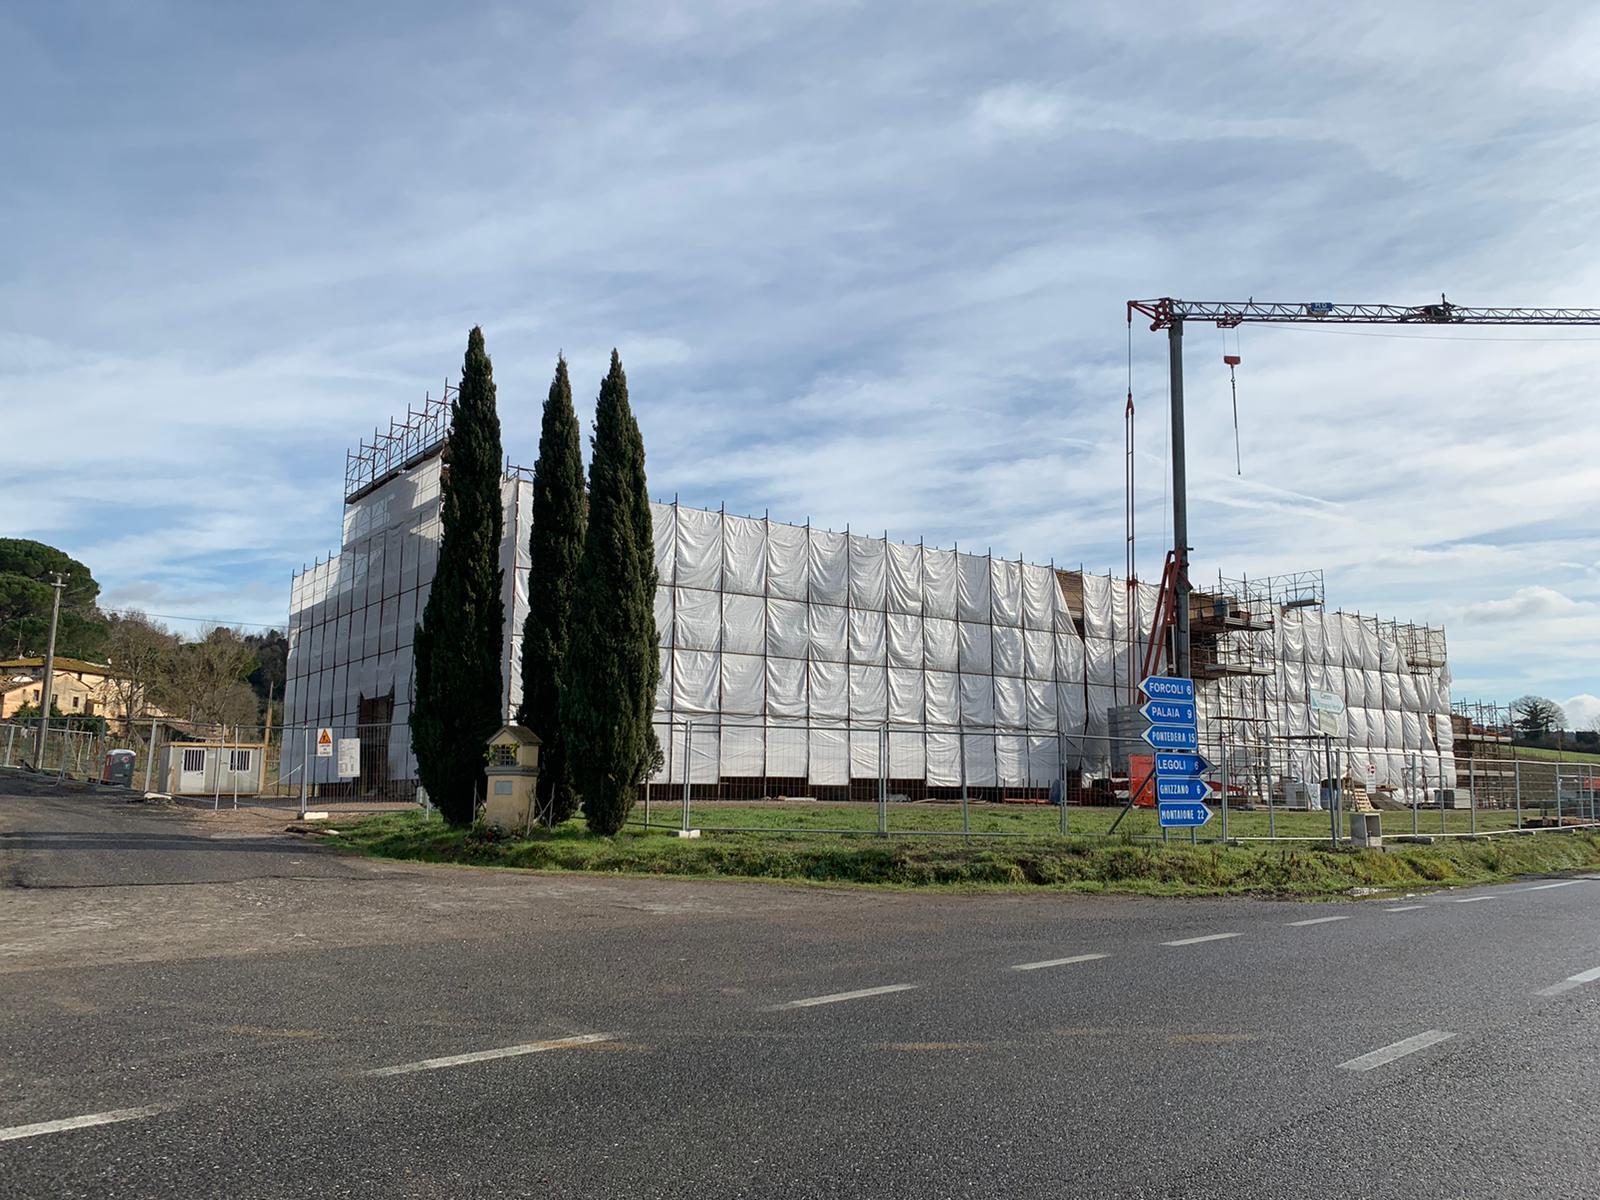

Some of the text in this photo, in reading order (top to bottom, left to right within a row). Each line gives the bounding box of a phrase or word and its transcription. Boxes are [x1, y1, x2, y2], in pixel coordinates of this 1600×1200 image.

[1149, 682, 1192, 695] FORCOLI 6
[1151, 706, 1193, 719] PALAIA 9
[1152, 731, 1195, 743] PONTEDERA 15
[1157, 759, 1200, 770] LEGOLI 6
[1160, 784, 1201, 795] GHIZZANO 6
[1161, 809, 1205, 820] MONTAIONE 22
